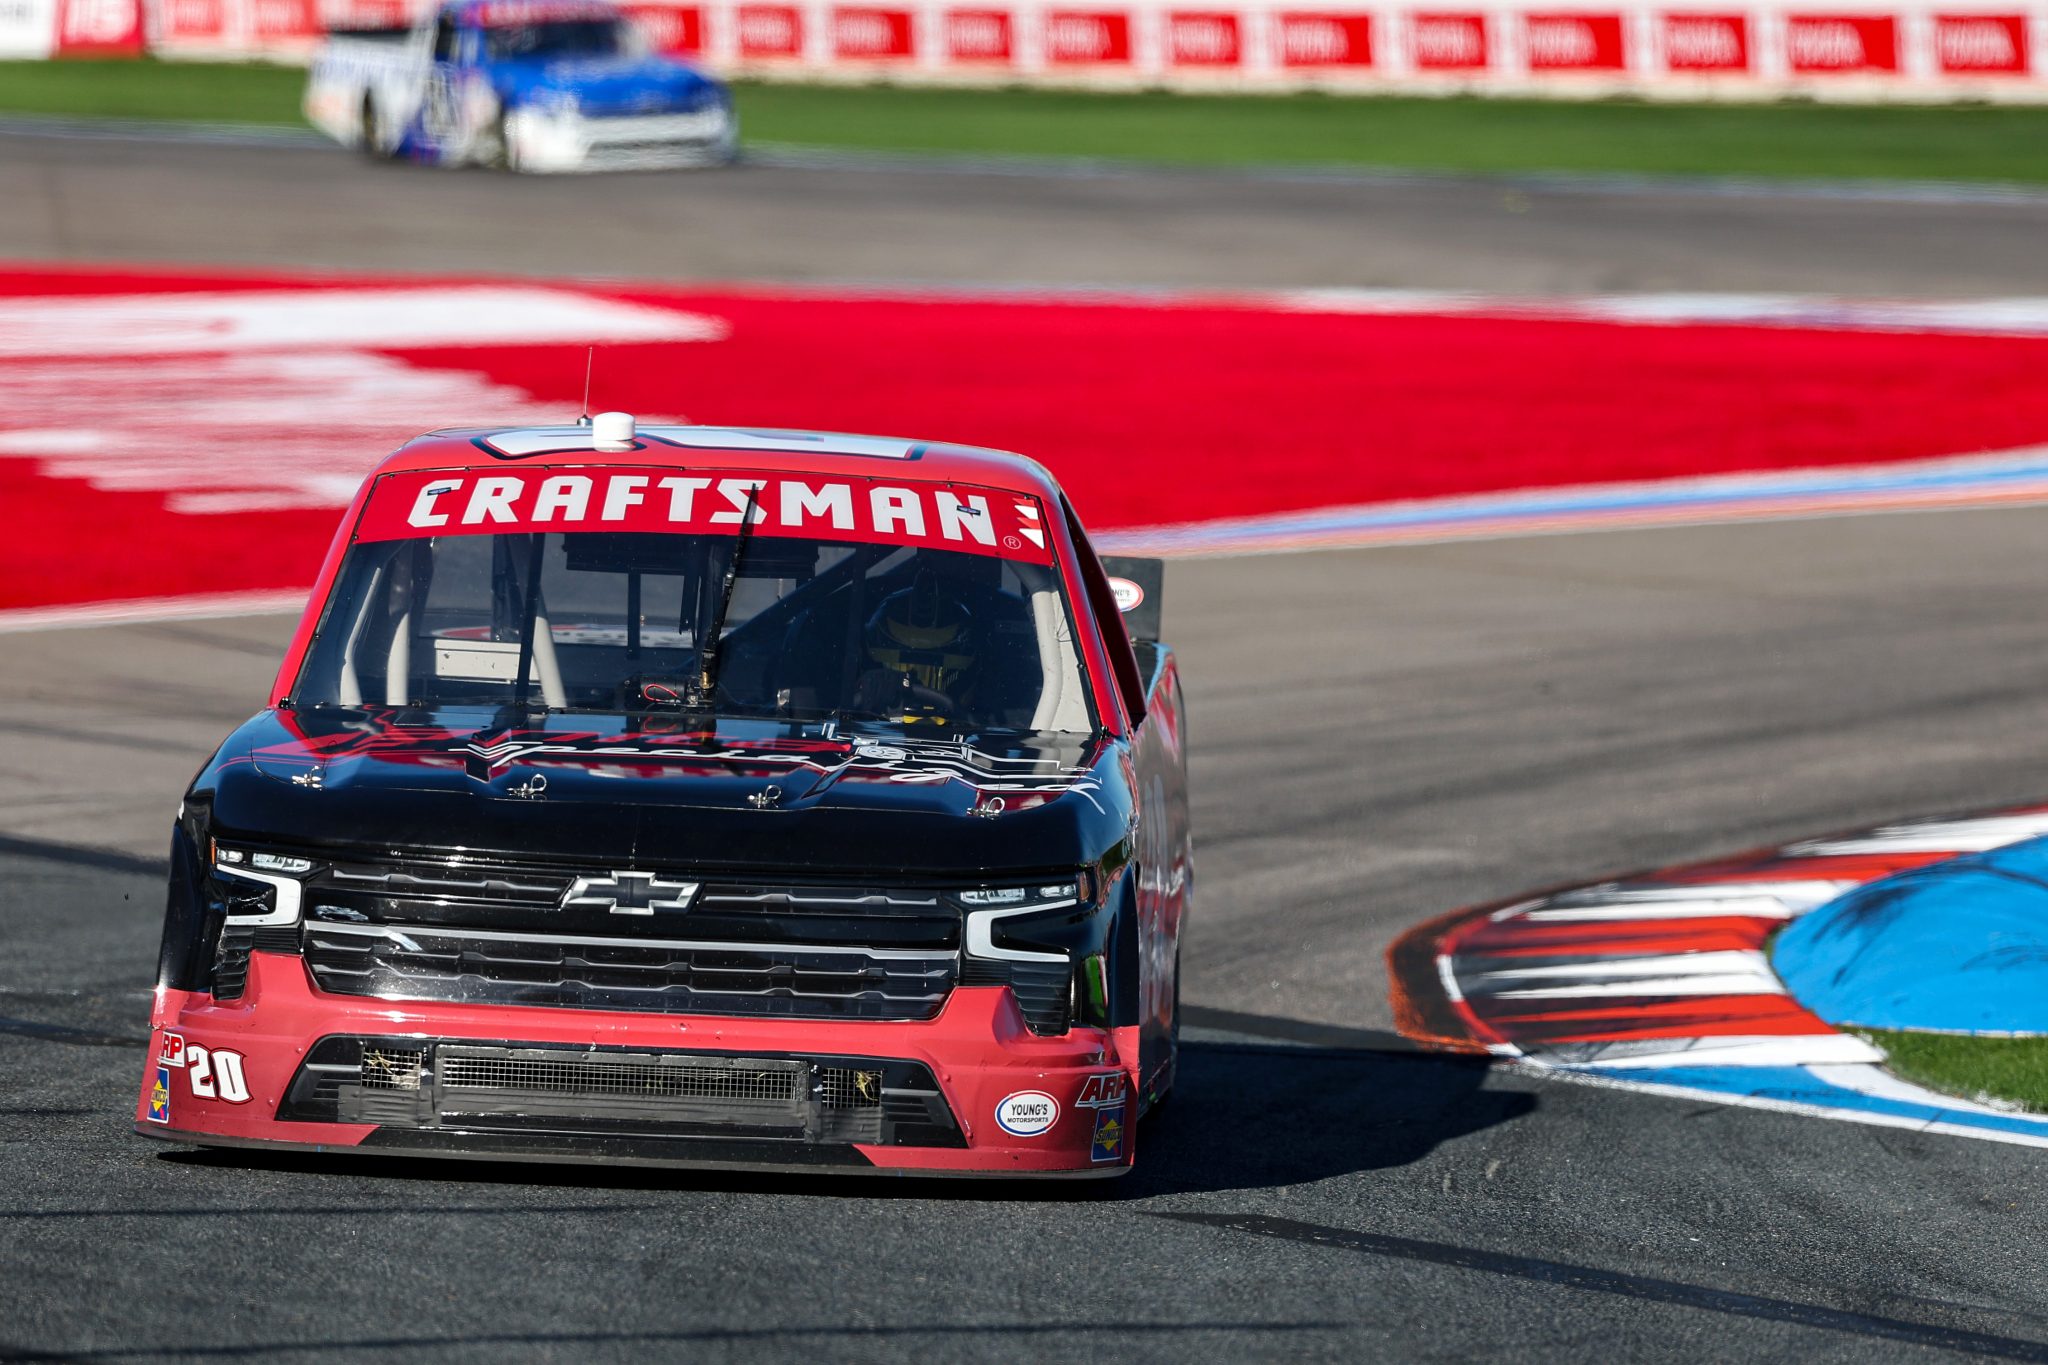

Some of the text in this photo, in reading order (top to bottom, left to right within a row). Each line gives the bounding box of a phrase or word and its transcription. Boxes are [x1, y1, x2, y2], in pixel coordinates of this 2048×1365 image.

[407, 475, 997, 547] CRAFTSMAN
[186, 1042, 254, 1105] 20
[1011, 1103, 1048, 1116] YOUNG'S
